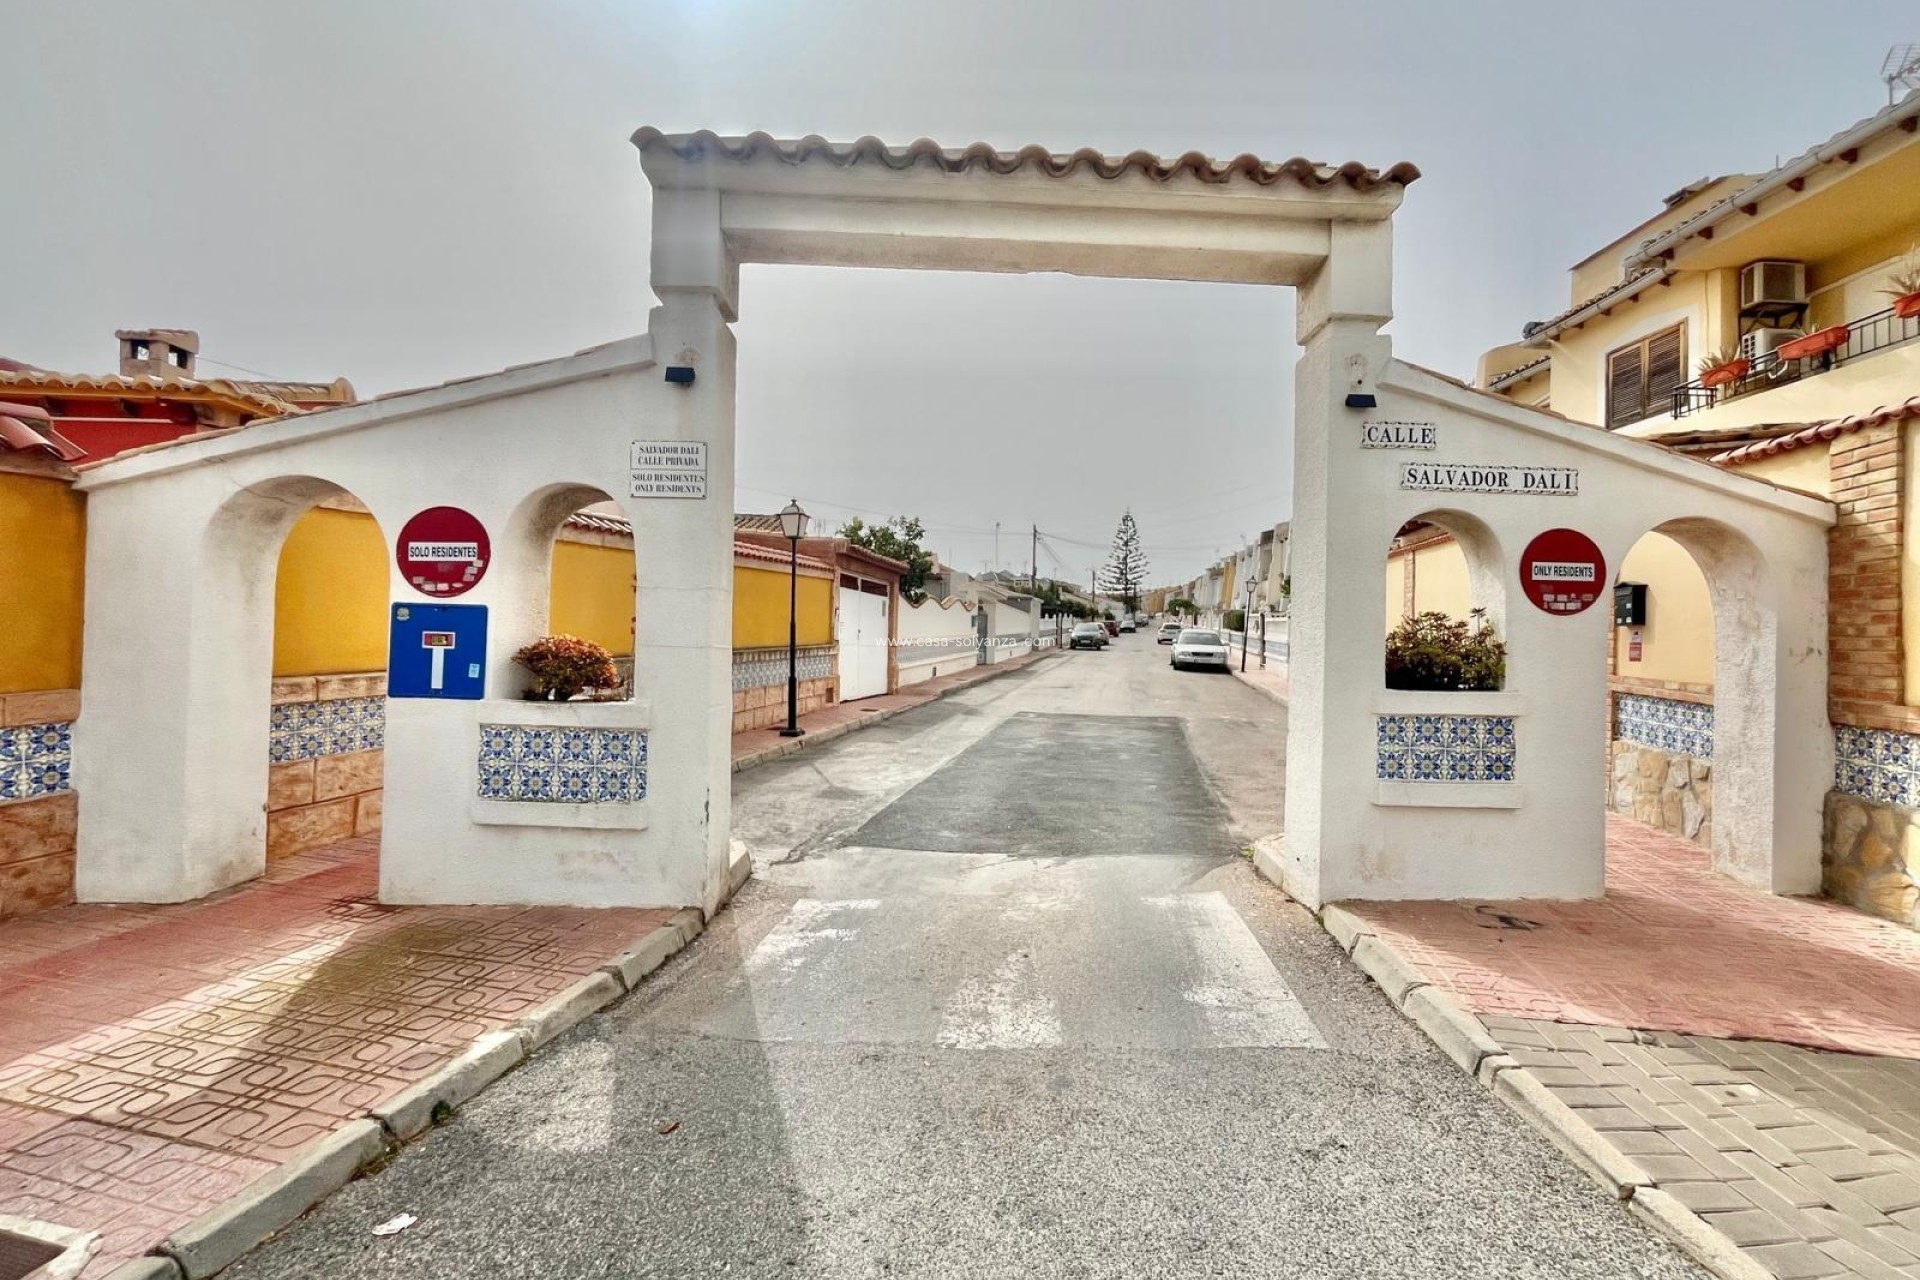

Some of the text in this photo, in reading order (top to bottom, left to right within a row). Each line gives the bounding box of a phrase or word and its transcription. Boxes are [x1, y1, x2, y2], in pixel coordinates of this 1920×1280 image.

[1367, 426, 1433, 444] CALLE
[640, 446, 699, 455] SALVADOR DALI
[638, 456, 699, 467] CALLE PRIVADA
[632, 474, 705, 483] SOLO RESIDENTES
[1406, 467, 1572, 490] SALVADOR DALI
[635, 484, 702, 493] ONLY RESIDENTS
[410, 546, 476, 558] SOLO RESIDENTES
[1534, 565, 1593, 578] ONLY RESIDENTS
